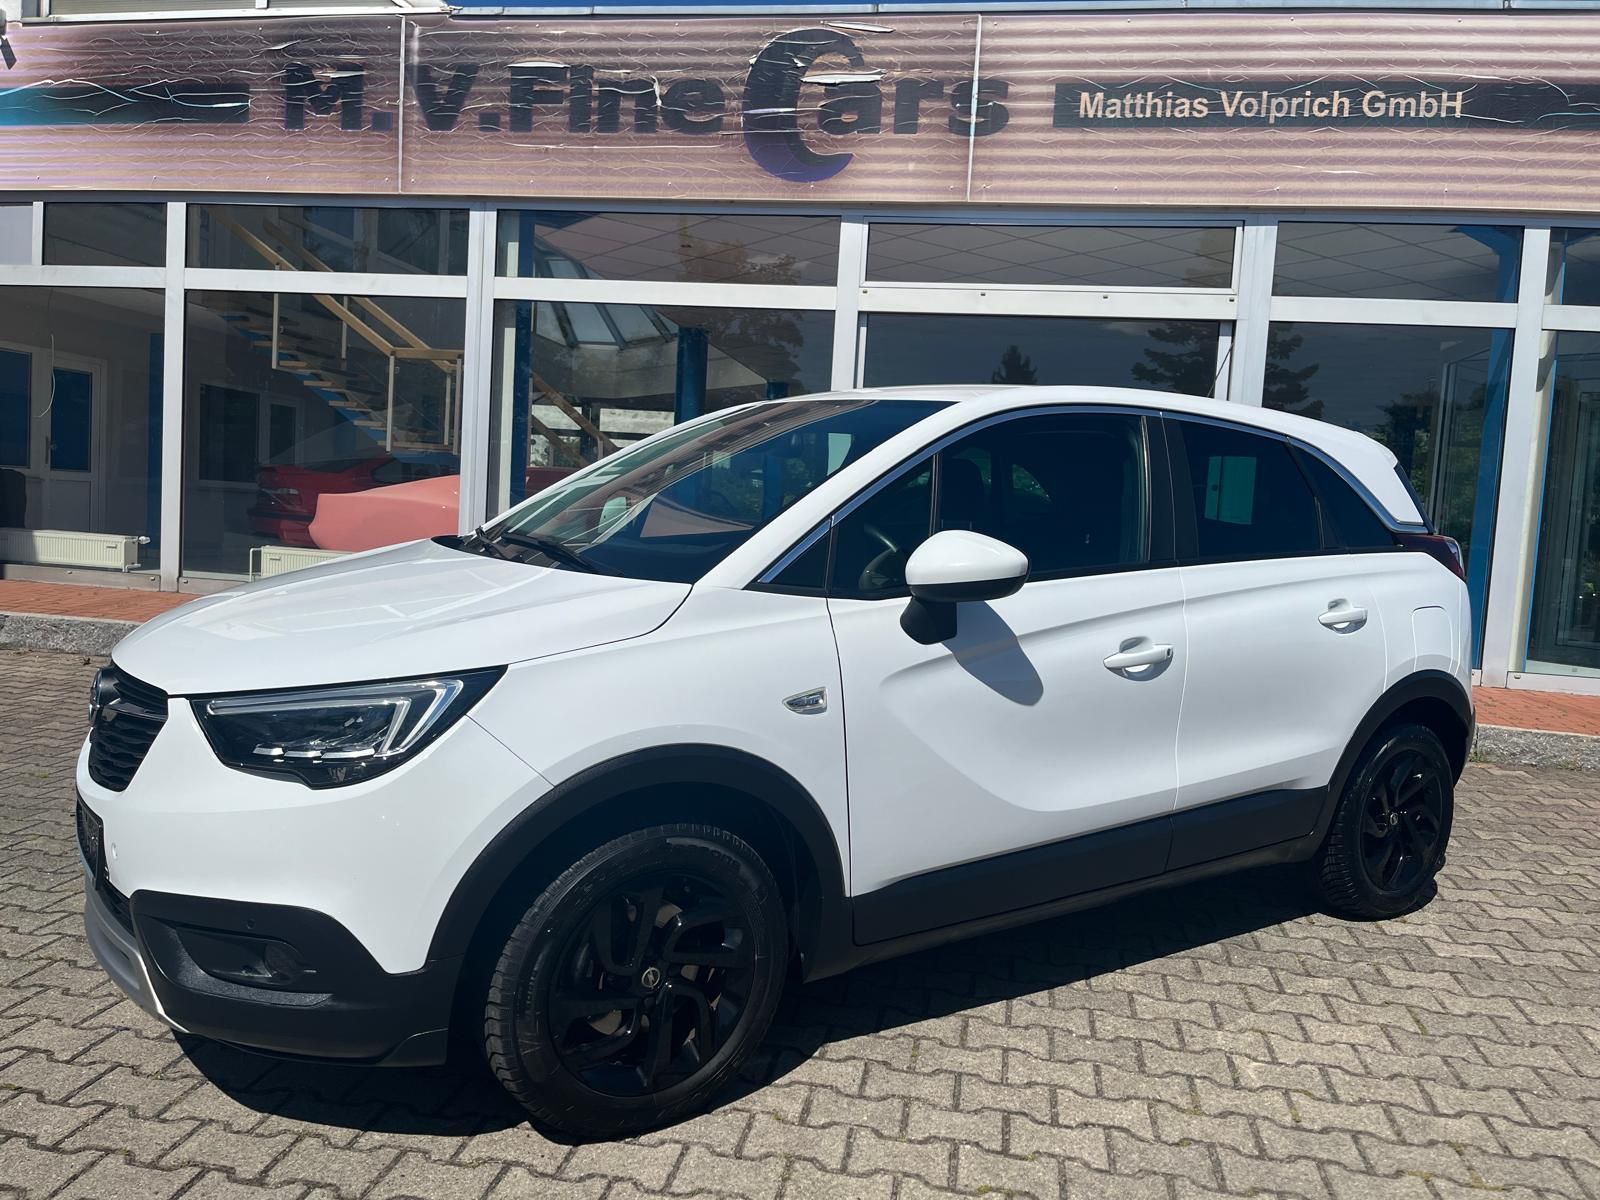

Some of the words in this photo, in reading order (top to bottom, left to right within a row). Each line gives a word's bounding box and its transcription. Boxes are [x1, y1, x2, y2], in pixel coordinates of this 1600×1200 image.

[1079, 91, 1209, 119] Matthias
[1220, 91, 1350, 124] Volprich
[1362, 90, 1463, 119] GmbH
